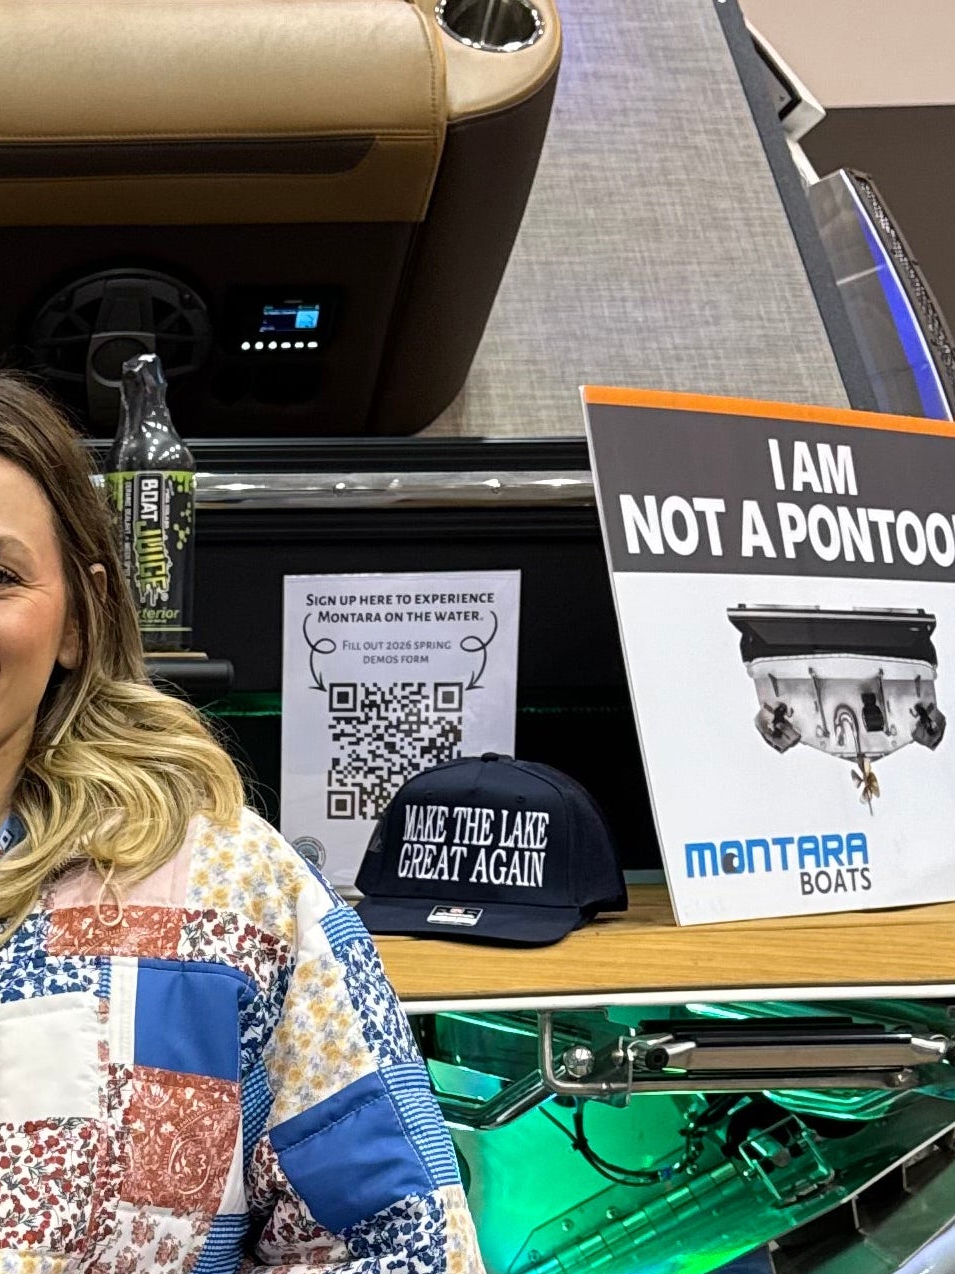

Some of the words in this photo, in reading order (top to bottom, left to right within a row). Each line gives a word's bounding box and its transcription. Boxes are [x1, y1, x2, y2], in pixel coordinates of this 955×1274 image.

[768, 438, 786, 491] I
[792, 440, 858, 496] AM
[140, 478, 159, 522] BOAT
[619, 494, 726, 556] NOT
[741, 500, 778, 558] A
[777, 502, 955, 567] PONTOO
[135, 520, 167, 593] JUICE
[306, 593, 337, 606] SIGN
[340, 595, 357, 606] UP
[360, 594, 393, 605] HERE
[396, 594, 412, 605] TO
[414, 592, 495, 604] EXPERIENCE
[317, 610, 382, 623] MONTARA
[384, 611, 404, 622] ON
[407, 611, 431, 622] THE
[342, 640, 361, 651] FILL
[363, 641, 384, 650] OUT
[386, 640, 412, 650] 2026
[414, 640, 452, 650] SPRING
[363, 655, 399, 664] DEMOS
[401, 655, 429, 664] FORM
[403, 804, 449, 844] MAKE
[453, 806, 495, 846] THE
[498, 809, 550, 850] LAKE
[397, 842, 468, 882] GREAT
[469, 847, 546, 888] AGAIN
[800, 867, 872, 896] BOATS
